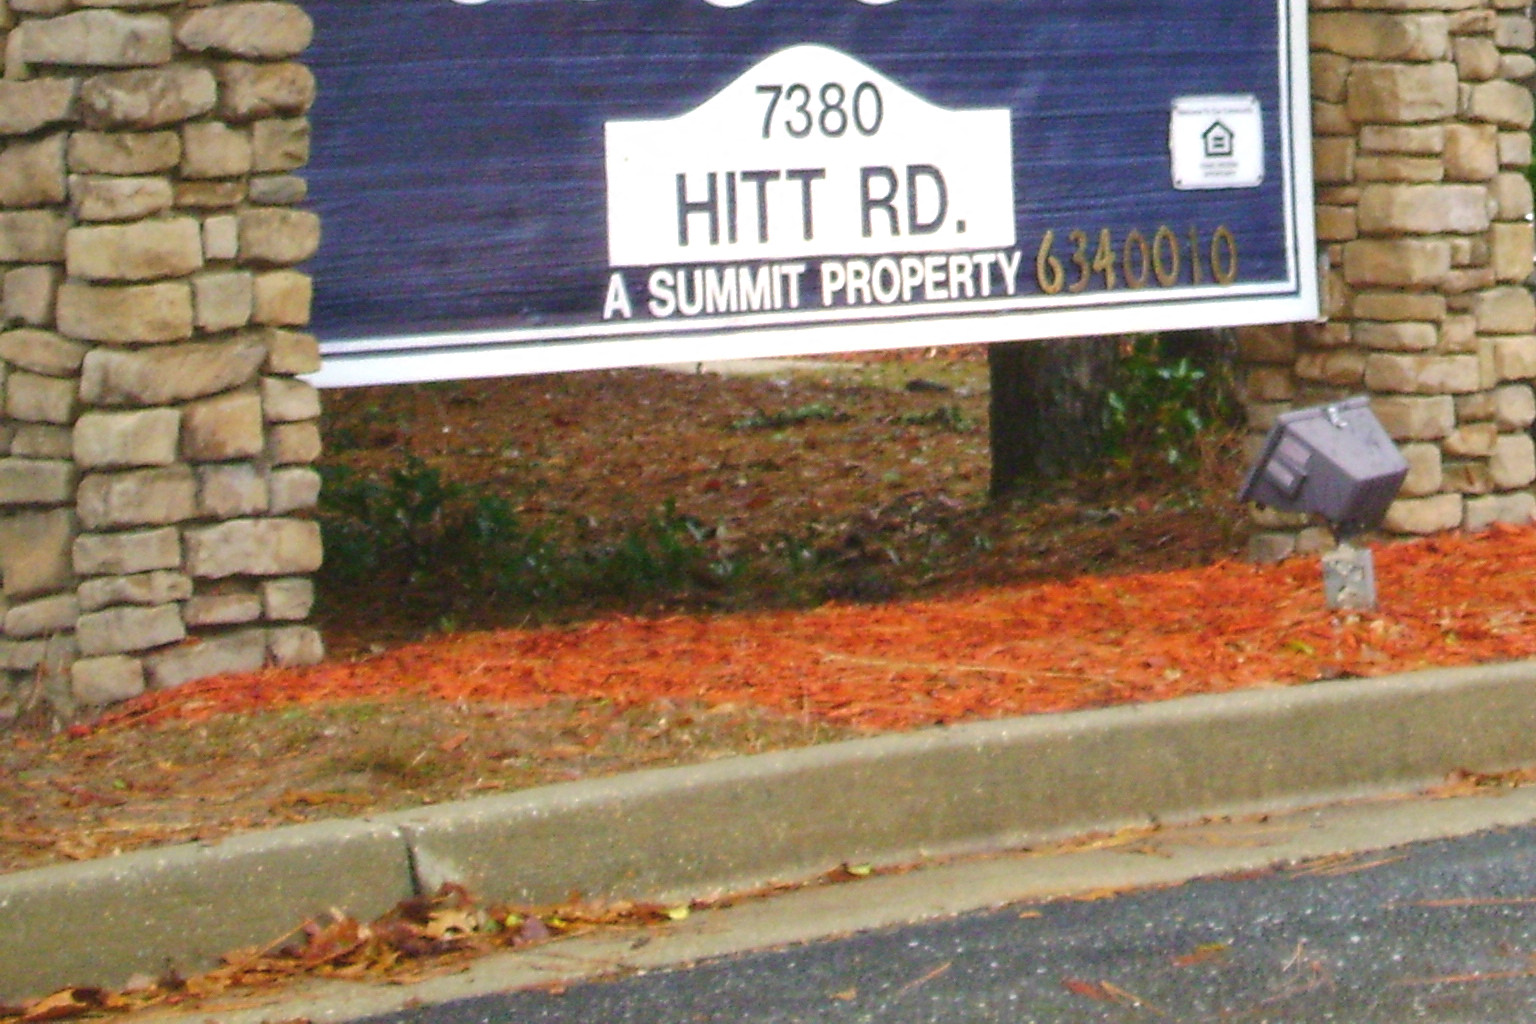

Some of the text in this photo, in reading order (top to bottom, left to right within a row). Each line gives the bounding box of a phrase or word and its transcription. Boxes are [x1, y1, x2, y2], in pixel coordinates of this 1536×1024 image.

[755, 81, 884, 139] 7380
[675, 163, 967, 247] HITT RD.
[603, 249, 1023, 320] A SUMMIT PROPERTY
[1036, 224, 1238, 295] 6340010
